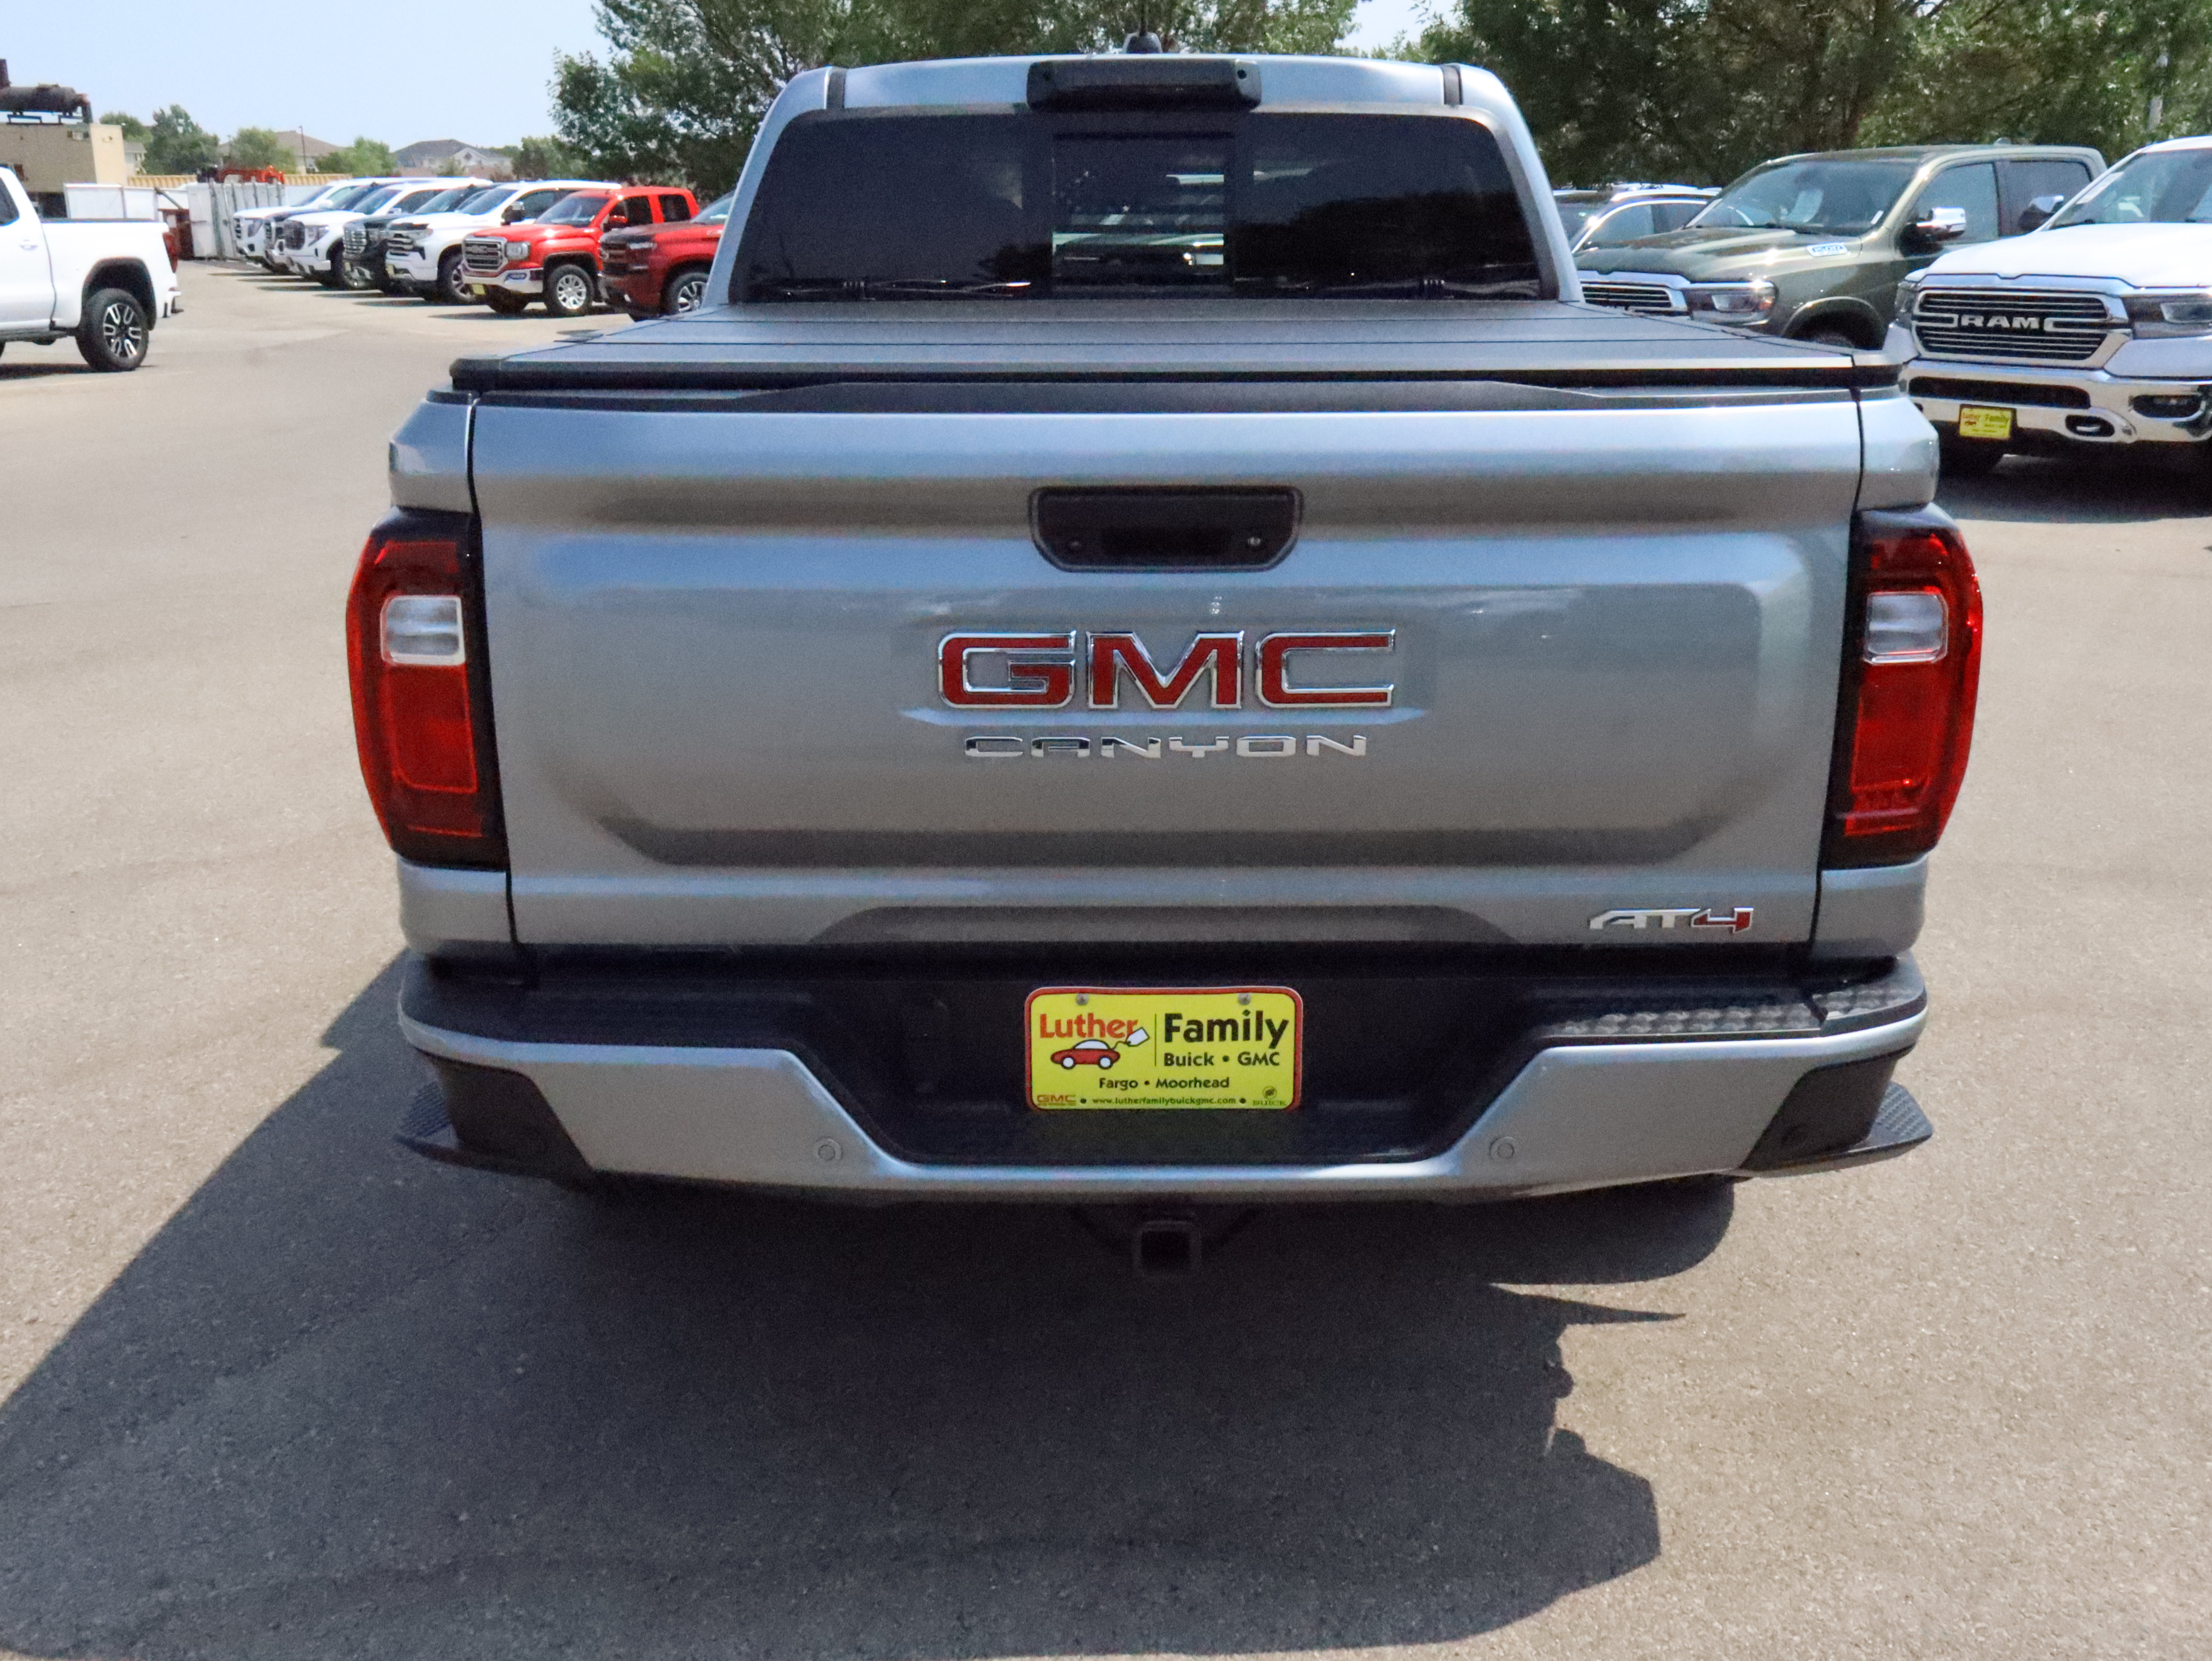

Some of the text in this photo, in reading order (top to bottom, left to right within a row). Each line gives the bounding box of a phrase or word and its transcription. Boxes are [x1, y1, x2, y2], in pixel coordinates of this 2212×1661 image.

[1961, 314, 2040, 329] RAM
[938, 630, 1396, 709] GMC
[964, 736, 1367, 758] CANYON
[1589, 906, 1754, 934] AT4
[1039, 1013, 1138, 1039] Luther
[1164, 1009, 1289, 1049] Family
[1164, 1051, 1280, 1067] Buick GMC
[1099, 1076, 1230, 1091] Fargo Moorhead
[1037, 1094, 1076, 1102] GMC
[1092, 1097, 1236, 1106] www.lutherfamilybuickgmc.com
